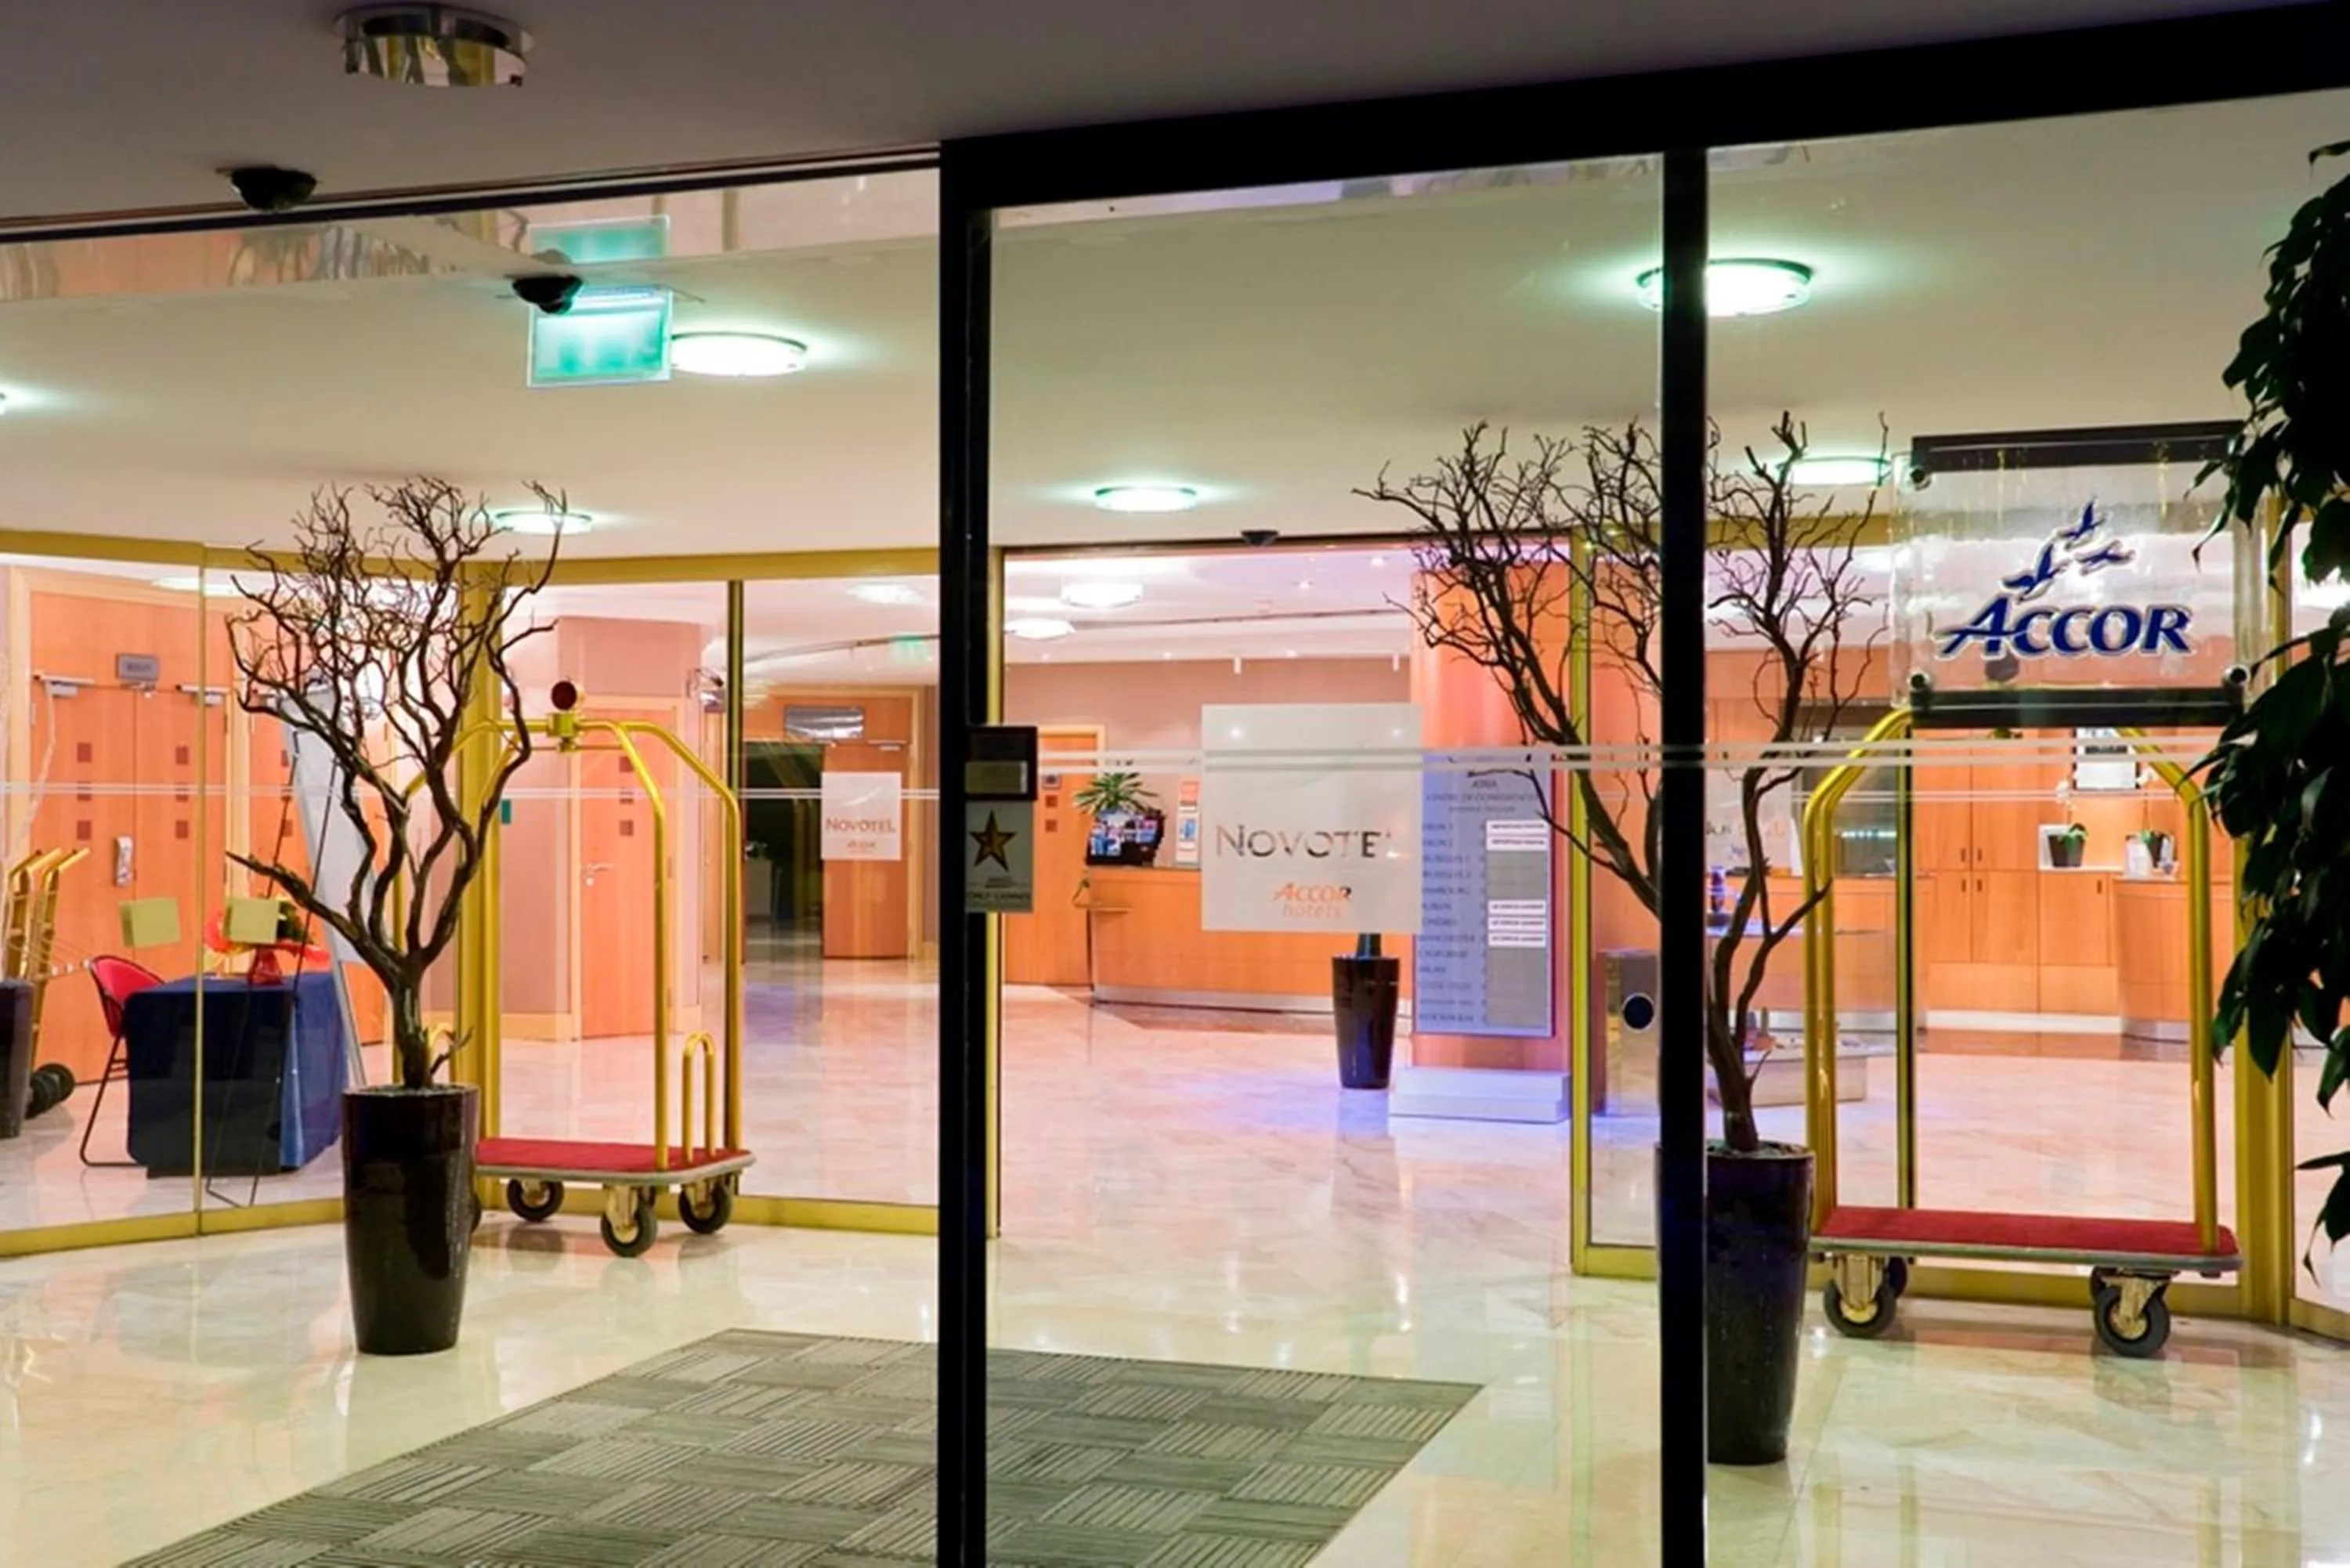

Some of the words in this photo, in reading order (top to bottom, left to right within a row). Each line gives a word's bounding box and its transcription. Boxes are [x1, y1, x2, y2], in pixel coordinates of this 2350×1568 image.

[1932, 593, 2193, 658] ACCOR
[826, 817, 896, 833] NOVOTEL
[1216, 823, 1401, 858] NOVOTE
[1273, 882, 1353, 901] ACCOR
[1283, 901, 1342, 919] hotels
